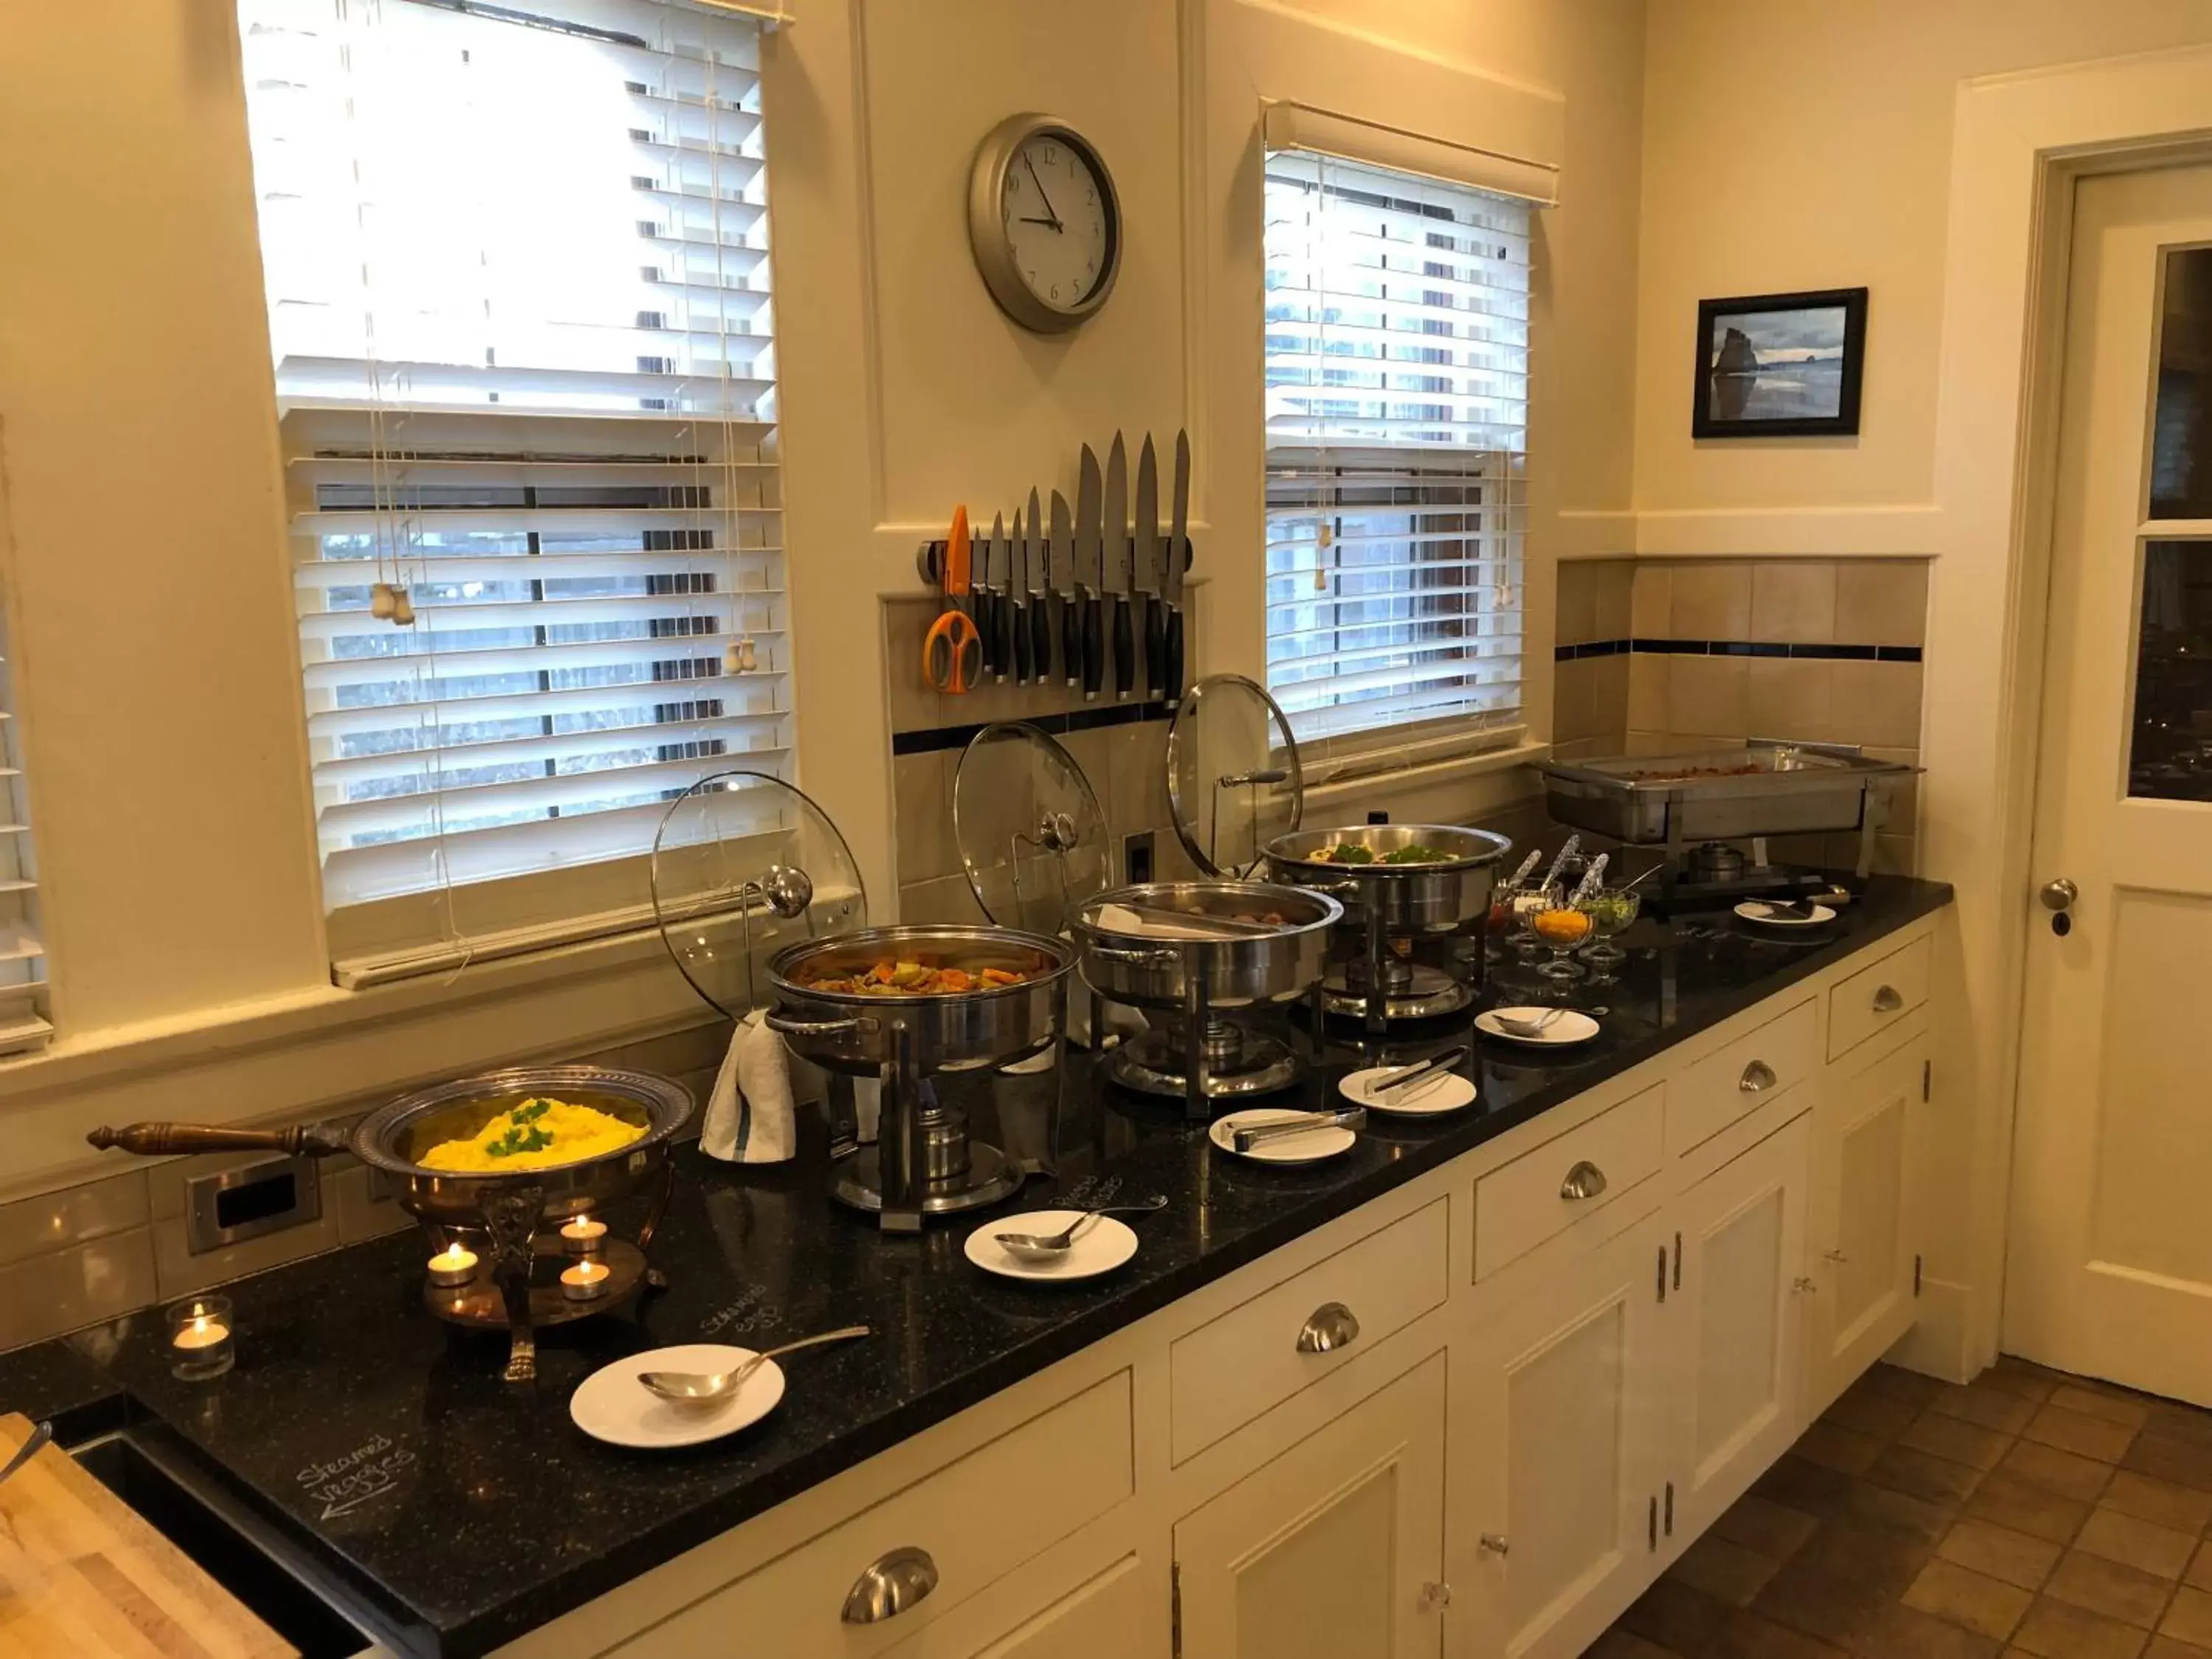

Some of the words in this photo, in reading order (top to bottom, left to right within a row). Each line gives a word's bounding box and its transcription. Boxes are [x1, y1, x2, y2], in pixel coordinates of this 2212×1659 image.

[1044, 146, 1057, 166] 12
[1086, 185, 1094, 206] 2
[1050, 283, 1060, 300] 6
[1073, 279, 1079, 296] 5
[296, 1435, 392, 1489] Steamed
